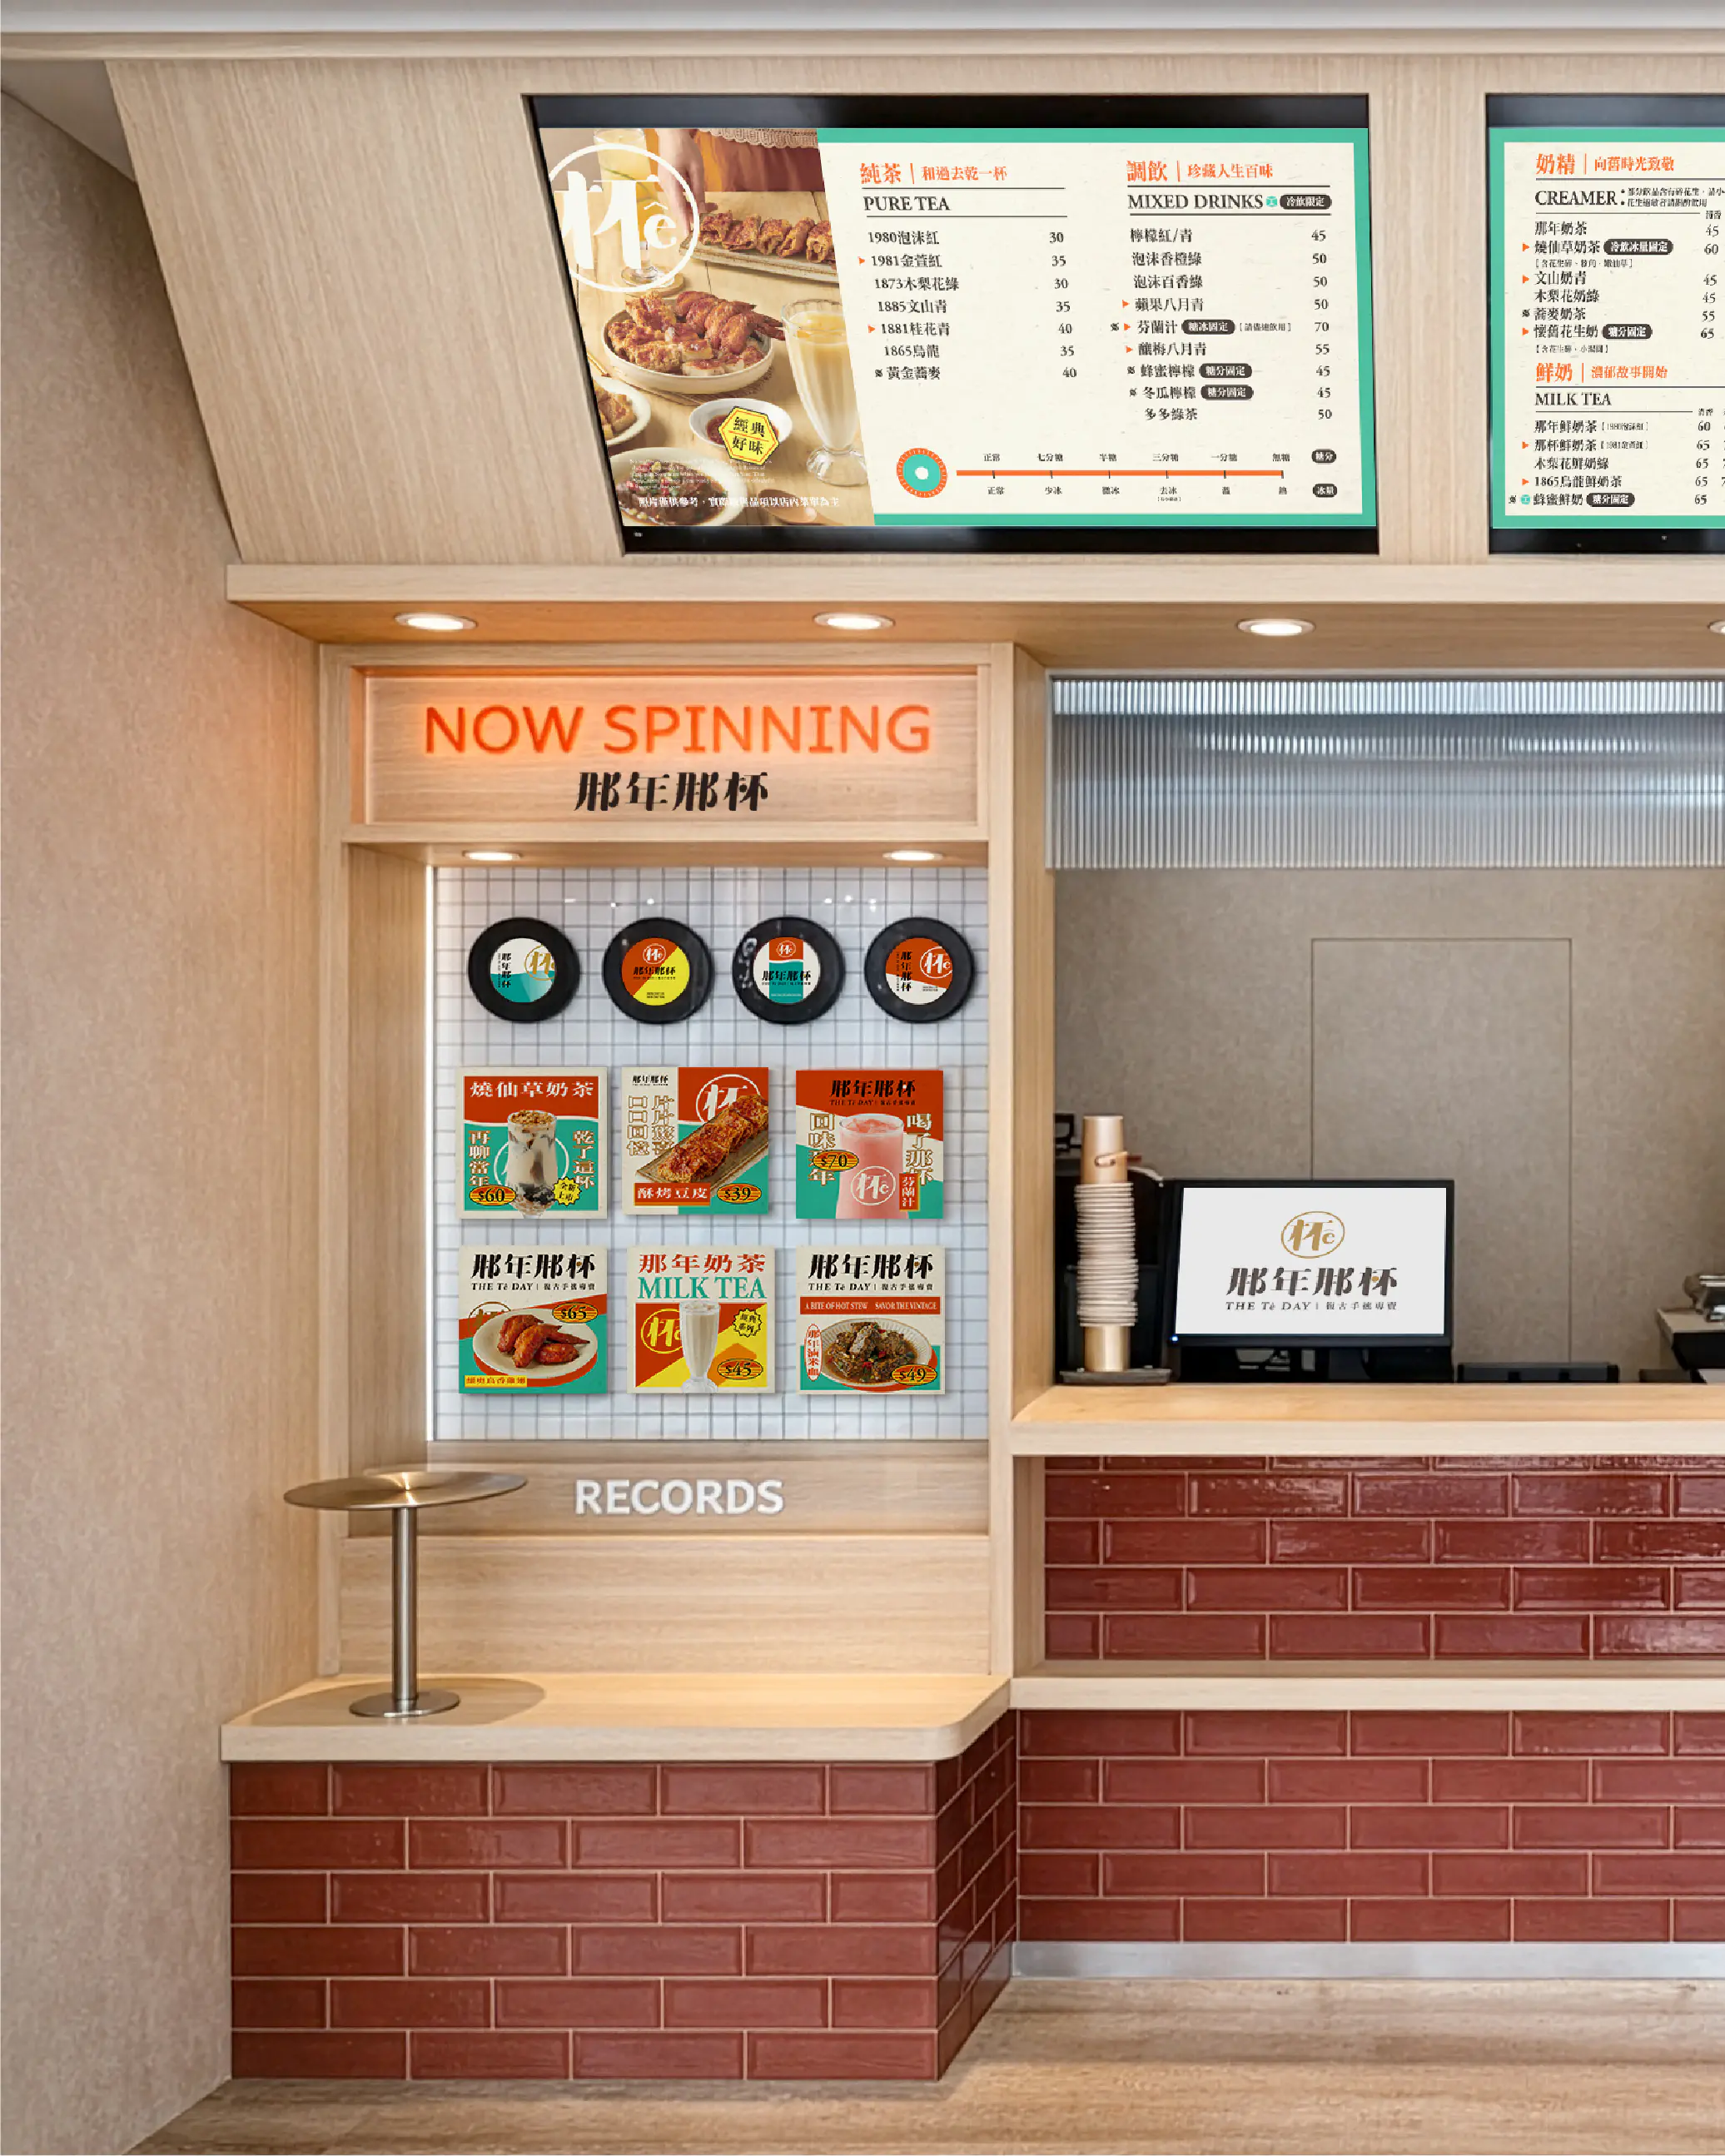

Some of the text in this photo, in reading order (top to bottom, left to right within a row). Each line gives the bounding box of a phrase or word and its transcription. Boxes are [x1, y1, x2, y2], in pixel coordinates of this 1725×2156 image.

[1127, 161, 1273, 181] 調飲 珍藏人生百味
[1536, 153, 1674, 175] 奶精 向舊時光致敬
[860, 163, 1007, 184] 純茶 和過去乾一杯
[863, 196, 950, 211] PURE TEA
[1128, 195, 1325, 209] MIXED DRINKS 冷飲限定
[1535, 191, 1618, 205] CREAMER
[1130, 228, 1325, 242] 檸檬紅/青 45
[1535, 221, 1718, 237] 那年奶茶 45
[868, 231, 1063, 245] 1980泡沫紅 30
[1535, 241, 1600, 255] 燒仙草奶茶
[1704, 244, 1718, 255] 60
[872, 255, 1066, 267] 1981金萱紅 35
[1131, 252, 1326, 266] 泡沫香橙綠 50
[1055, 278, 1069, 289] 30
[1134, 275, 1327, 288] 泡沫百香綠 50
[1535, 271, 1717, 286] 文山奶青 45
[1136, 298, 1329, 311] 蘋果八月青 50
[1703, 292, 1715, 303] 45
[878, 300, 1070, 313] 1885文山青 35
[1534, 307, 1714, 322] 蕎麥奶茶 55
[882, 322, 1071, 336] 1881桂花青 40
[1138, 320, 1177, 334] 芬蘭汁
[1315, 322, 1329, 331] 70
[1534, 325, 1598, 338] 懷舊花生奶
[1701, 328, 1714, 339] 65
[1061, 345, 1074, 356] 35
[1316, 344, 1330, 355] 55
[1063, 367, 1076, 377] 40
[1141, 364, 1330, 377] 蜂蜜檸檬 糖分固定 45
[1536, 363, 1668, 383] 鮮奶 濃郁故事開始
[1144, 386, 1330, 399] 冬瓜檸檬 糖分固定 45
[1535, 392, 1612, 405] MILK TEA
[1145, 408, 1332, 420] 多多綠茶 50
[733, 416, 765, 438] 經典
[1535, 420, 1710, 433] 那年鮮奶茶 60
[733, 435, 763, 455] 好味
[1535, 440, 1709, 451] 那杯鮮奶茶 65
[1696, 458, 1708, 469] 65
[1696, 476, 1708, 487] 65
[1534, 494, 1583, 505] 蜂蜜鮮奶
[1695, 494, 1707, 504] 65
[426, 704, 932, 754] NOW SPINNING
[575, 771, 768, 812] 那年那杯
[470, 1080, 594, 1098] 燒仙草奶茶
[830, 1080, 916, 1097] 那年那杯
[626, 1095, 650, 1156] 口口回憶
[821, 1155, 848, 1169] $70
[478, 1188, 505, 1202] $60
[638, 1187, 708, 1200] 酥烤豆皮
[725, 1187, 752, 1201] $39
[470, 1254, 596, 1279] 那年那杯
[639, 1254, 766, 1274] 那年奶茶
[808, 1254, 934, 1279] 那年那杯
[471, 1283, 494, 1291] THE
[512, 1283, 534, 1291] DAY
[638, 1276, 768, 1299] MILK TEA
[808, 1283, 832, 1291] THE
[849, 1283, 872, 1291] DAY
[1225, 1267, 1399, 1296] 那年那杯
[811, 1301, 824, 1309] BITE
[825, 1301, 835, 1309] OF
[835, 1301, 850, 1309] HOT
[851, 1301, 868, 1309] STEW
[875, 1301, 897, 1309] SAVOR
[897, 1301, 910, 1309] THE
[910, 1301, 937, 1309] VINTAGE
[1225, 1301, 1255, 1310] THE
[1280, 1301, 1312, 1310] DAY
[561, 1305, 587, 1320] $65
[726, 1362, 752, 1377] $45
[900, 1367, 927, 1382] $49
[574, 1479, 785, 1515] RECORDS
